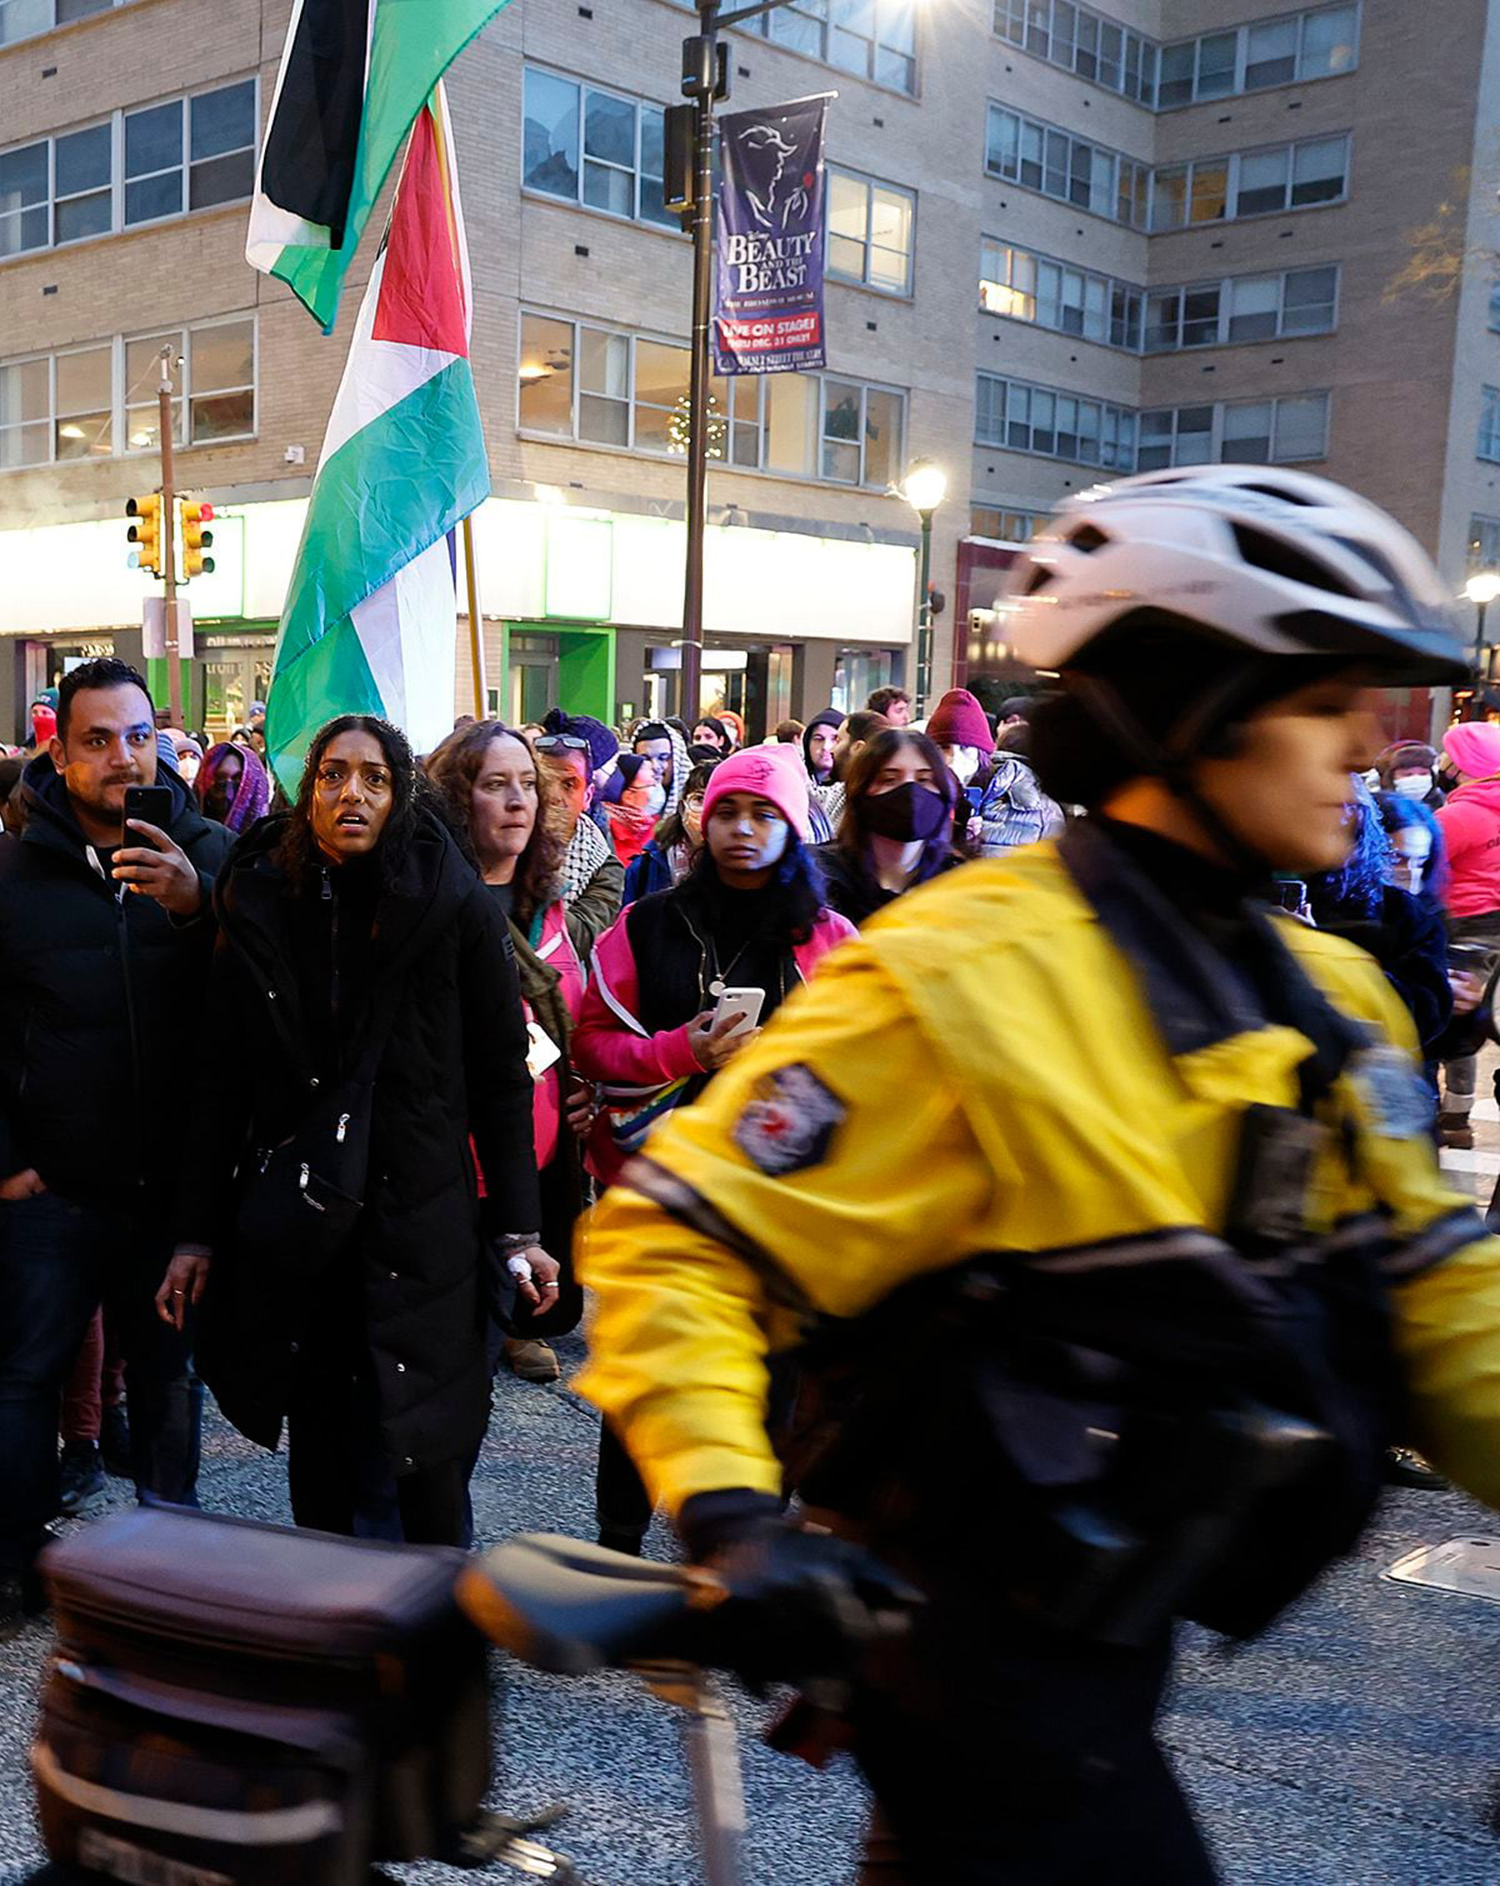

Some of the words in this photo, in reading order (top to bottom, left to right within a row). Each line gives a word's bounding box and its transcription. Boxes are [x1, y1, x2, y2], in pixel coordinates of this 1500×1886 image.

[726, 231, 816, 265] BEAUTY
[760, 259, 784, 270] AND
[737, 264, 807, 293] BEAST
[752, 323, 775, 337] ON
